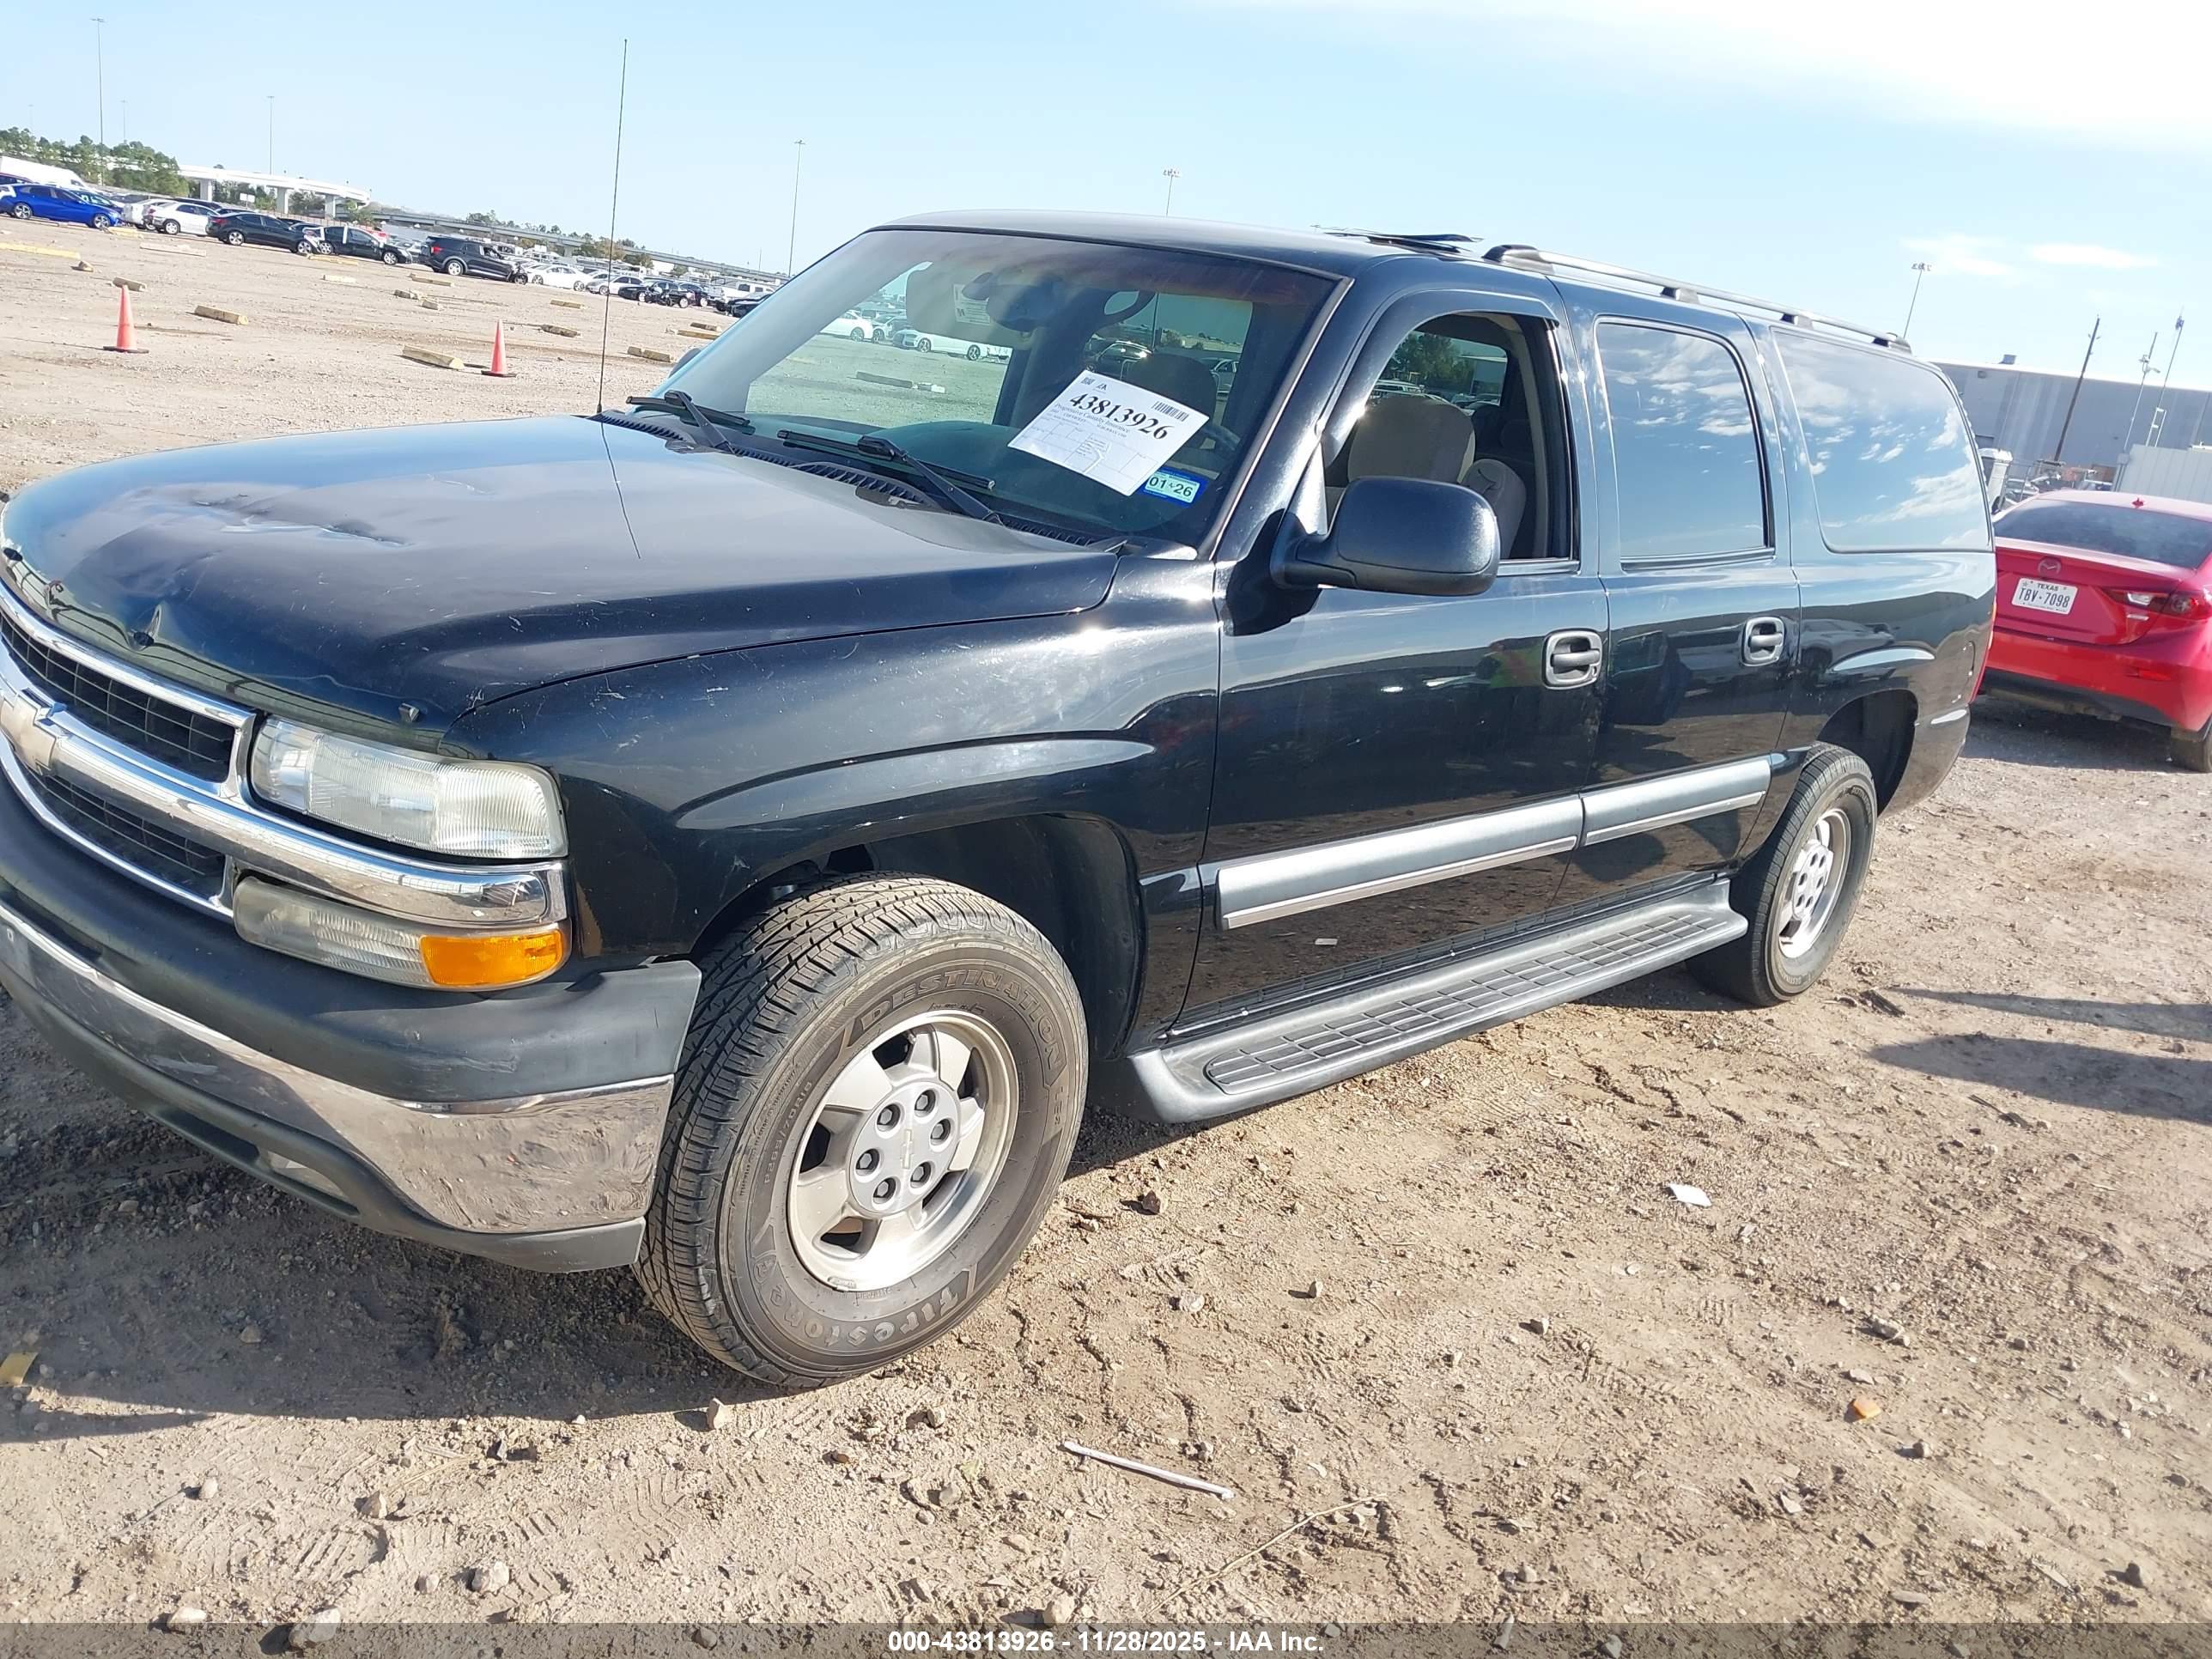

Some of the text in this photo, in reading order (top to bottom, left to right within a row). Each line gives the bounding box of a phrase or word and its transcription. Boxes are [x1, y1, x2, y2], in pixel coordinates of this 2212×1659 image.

[1070, 392, 1175, 441] 43813926
[1149, 476, 1168, 489] 01
[1174, 483, 1194, 497] 26
[2037, 582, 2059, 592] TEXAS
[860, 969, 1062, 1071] DESTINATION
[769, 1285, 959, 1347] Firestone
